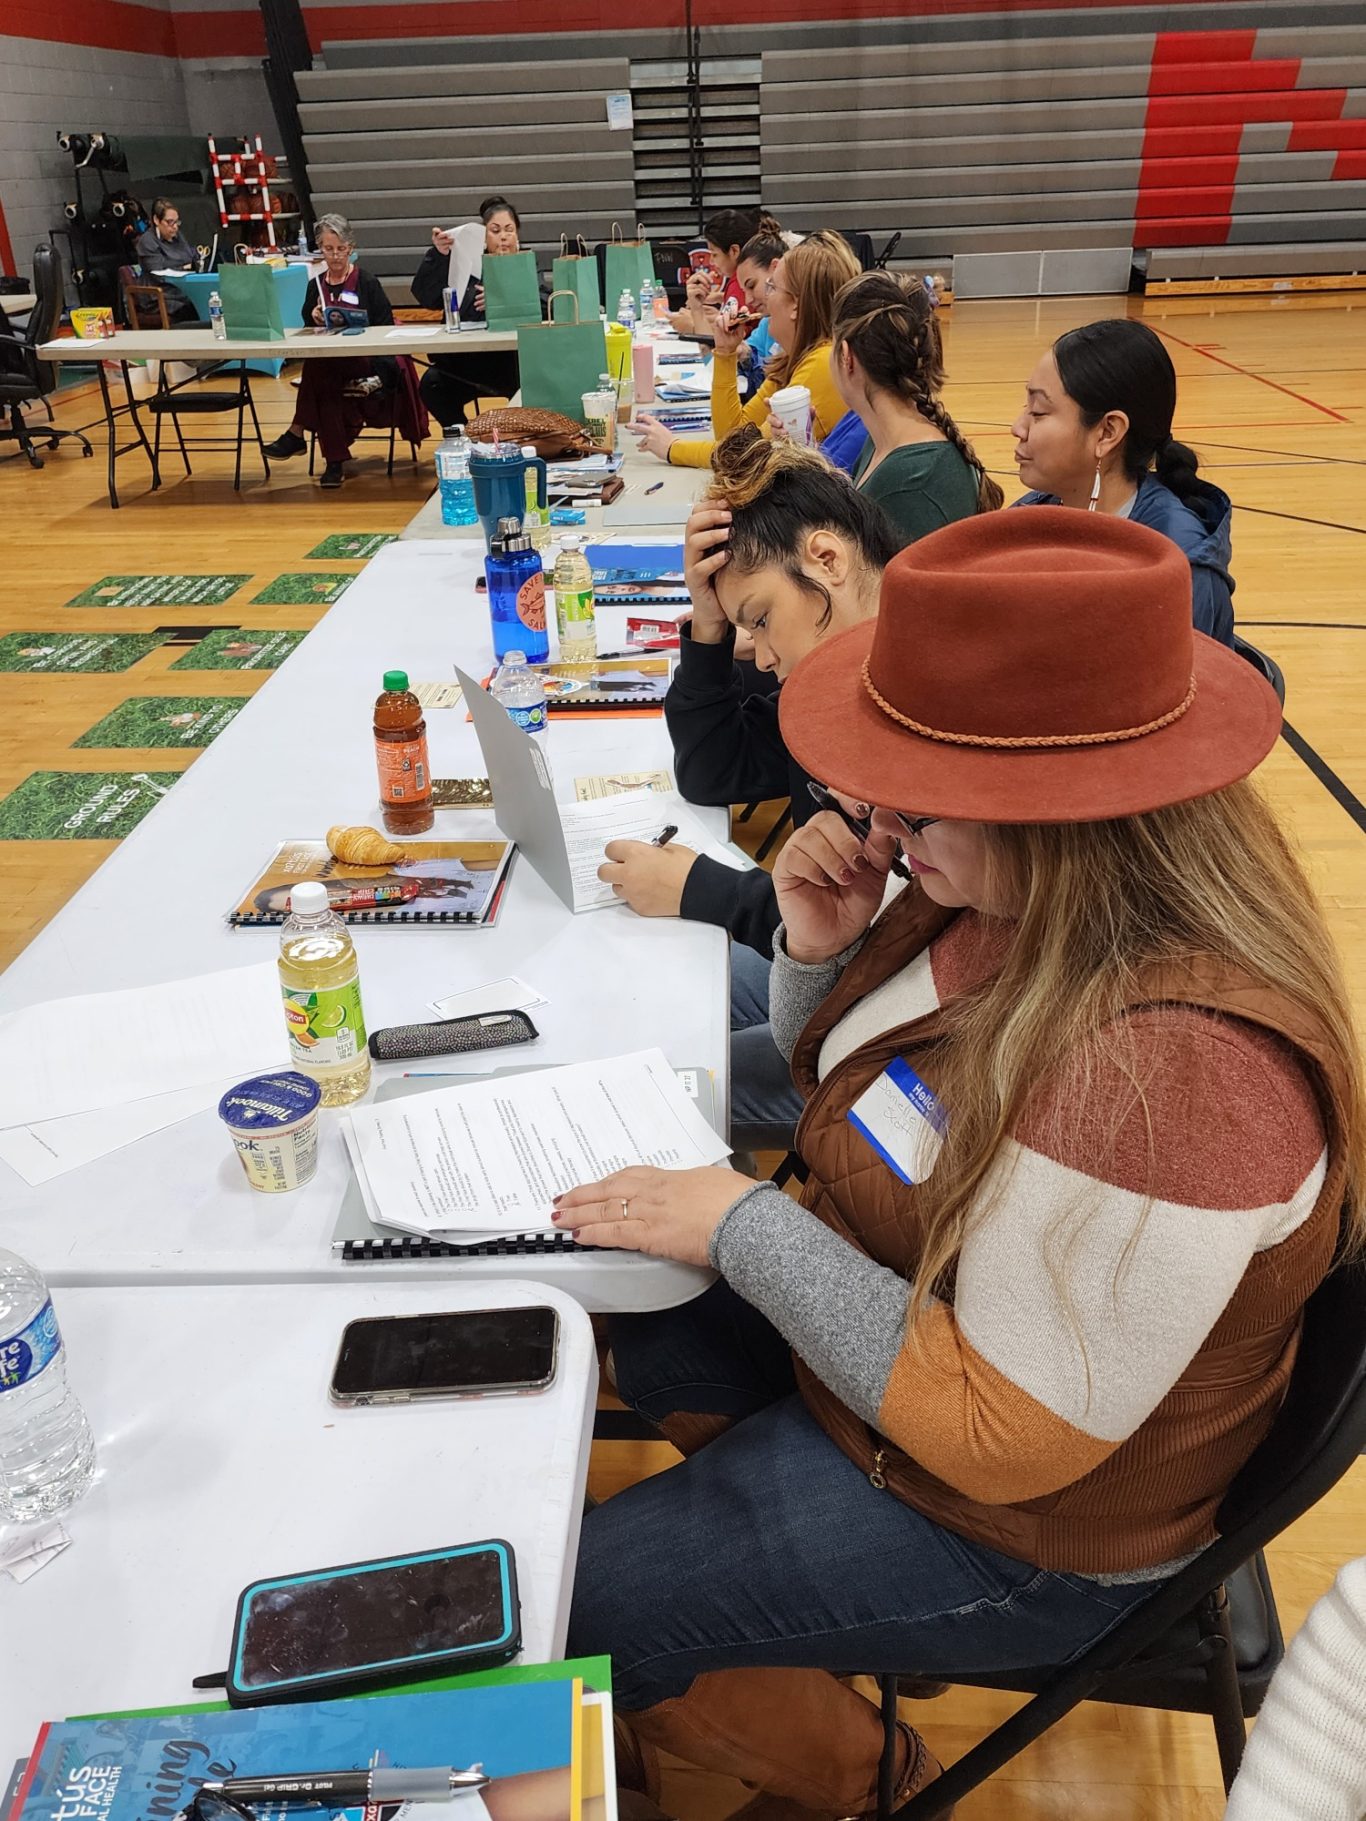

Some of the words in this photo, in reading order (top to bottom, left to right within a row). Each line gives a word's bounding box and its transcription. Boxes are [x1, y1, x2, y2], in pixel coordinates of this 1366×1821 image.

[520, 575, 540, 600] SAVE
[528, 618, 546, 630] SAL
[64, 784, 119, 829] GROUND
[97, 787, 141, 824] RULES
[226, 1097, 293, 1121] Tillamook
[912, 1083, 935, 1111] Hello
[0, 1342, 20, 1358] re
[51, 1766, 91, 1821] tús
[80, 1766, 112, 1816] FACE
[103, 1766, 123, 1807] HEALTH
[97, 1807, 110, 1821] AL
